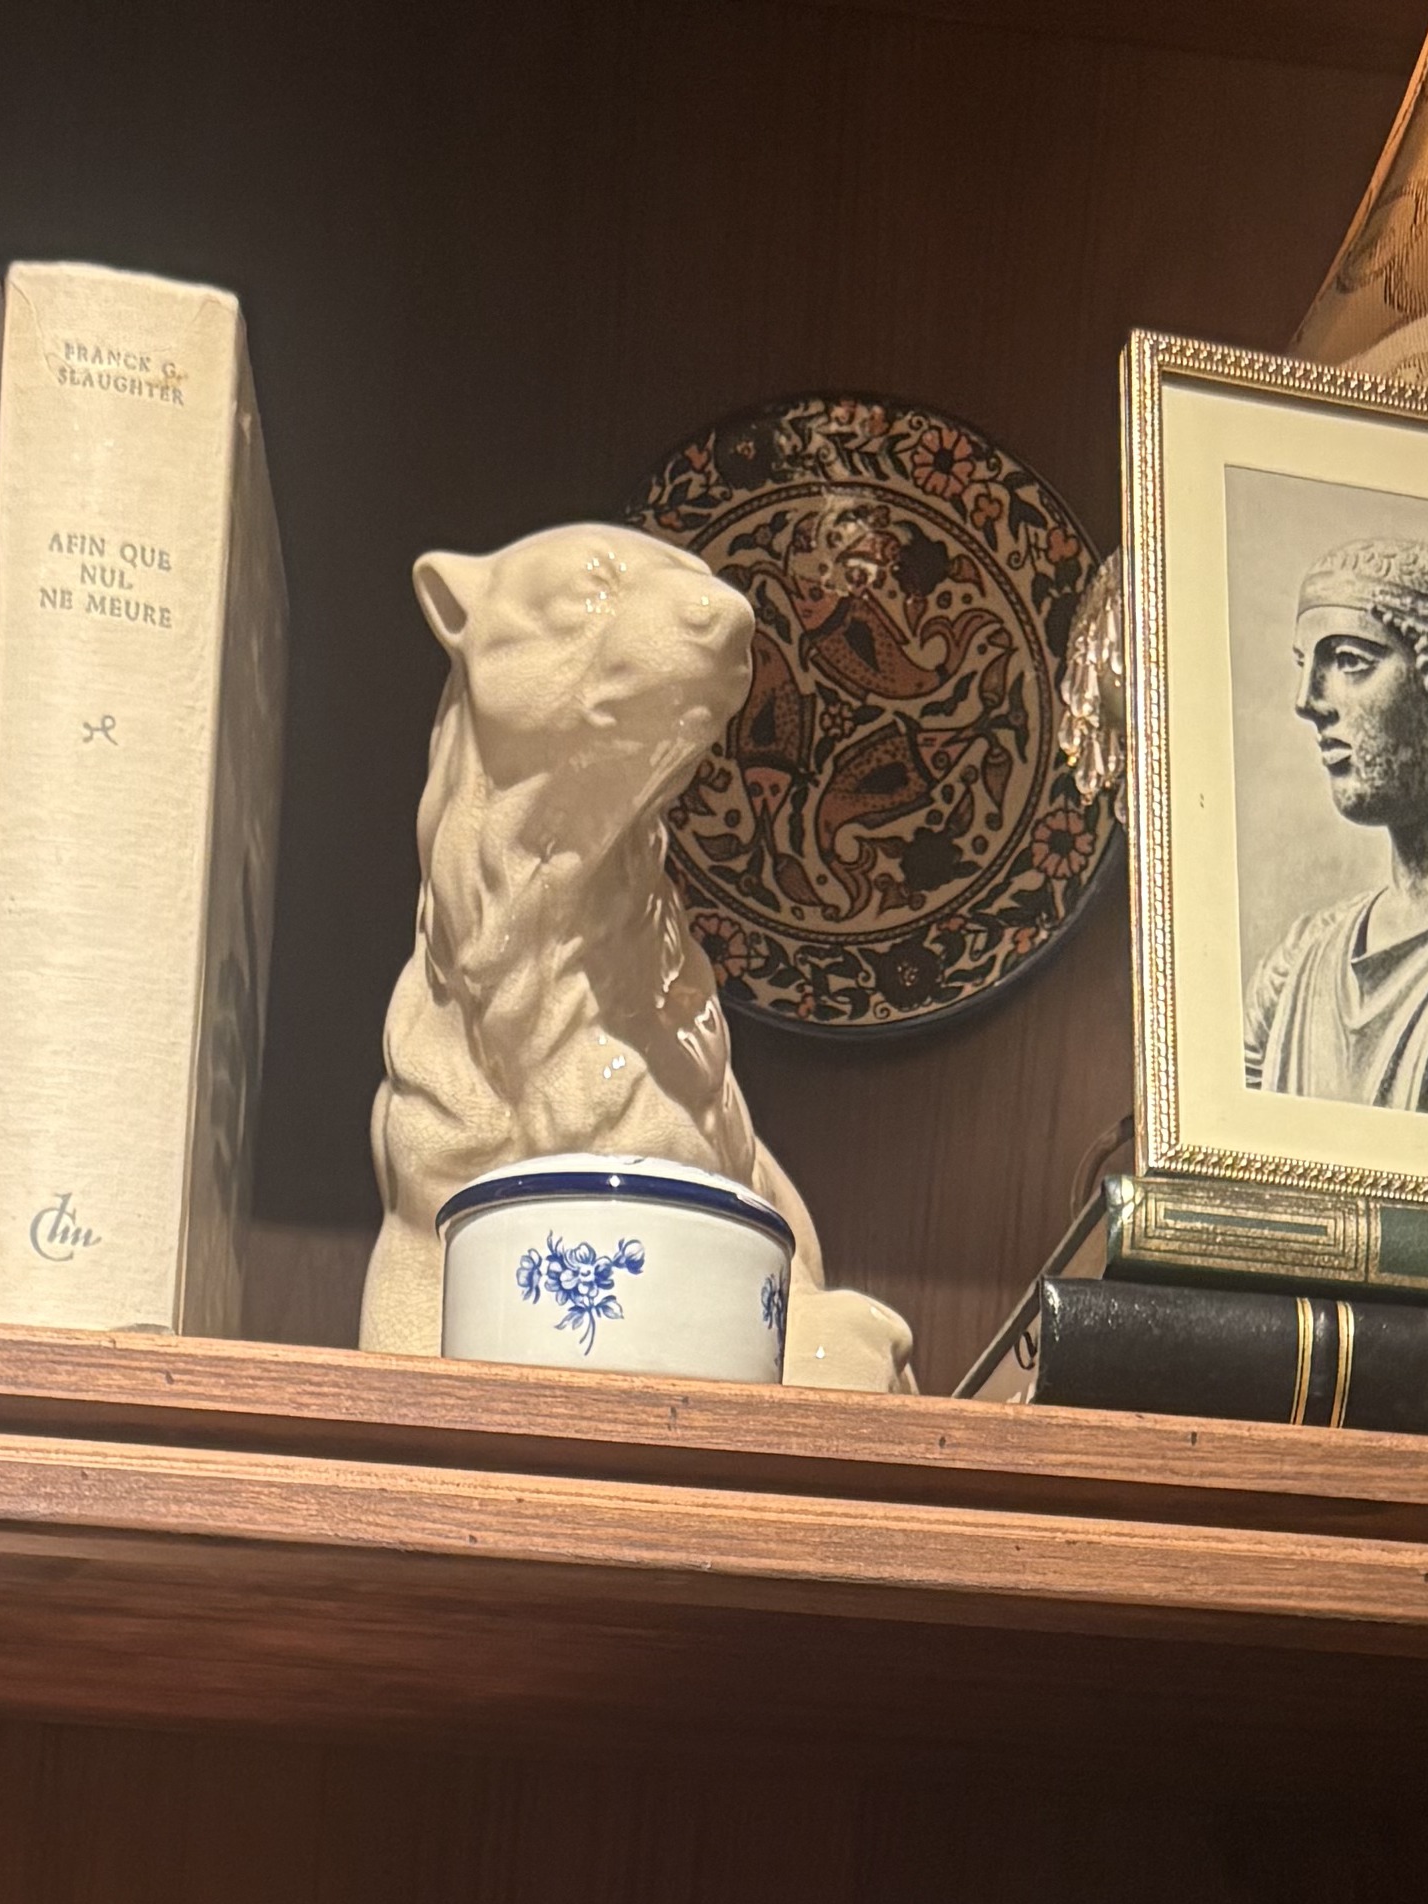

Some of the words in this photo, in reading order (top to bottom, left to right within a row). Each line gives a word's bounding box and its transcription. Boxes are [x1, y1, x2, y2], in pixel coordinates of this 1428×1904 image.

[63, 341, 150, 373] FRANCK
[57, 366, 184, 407] SLAUGHTER
[48, 533, 106, 559] AFIN
[119, 543, 172, 572] QUE
[80, 562, 133, 591] NUL
[39, 587, 73, 611] NE
[85, 594, 173, 630] MEURE
